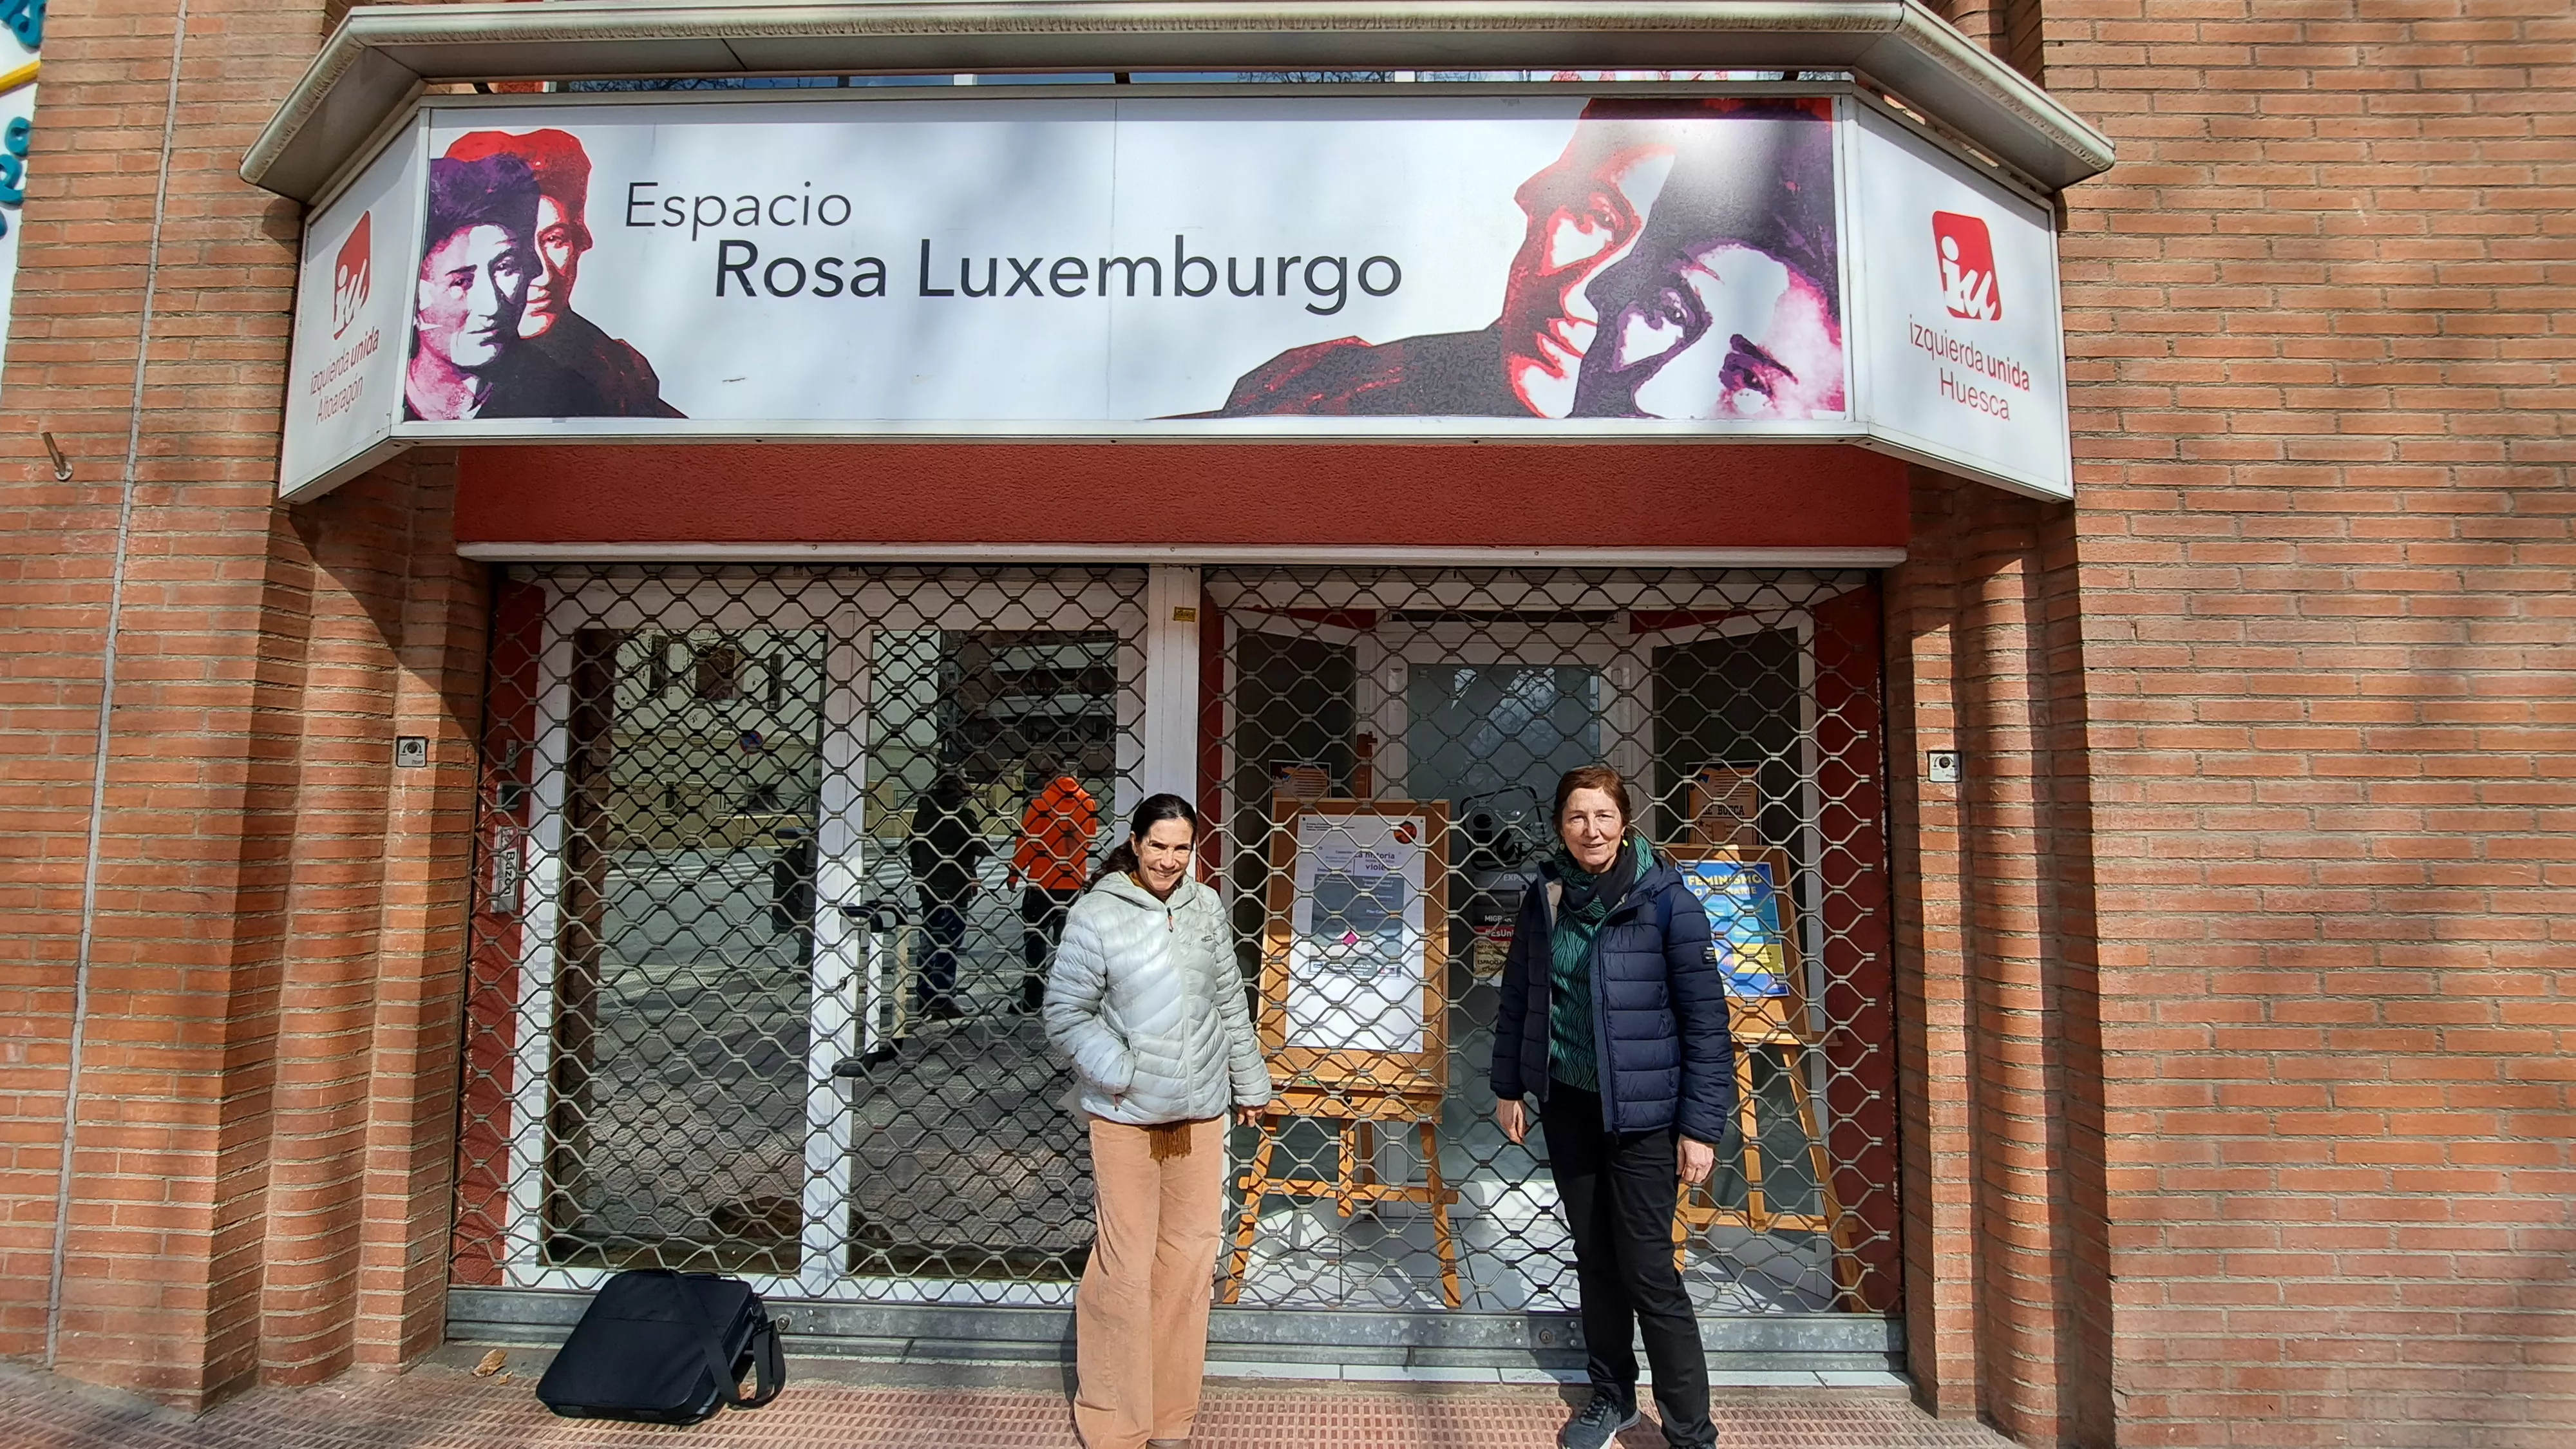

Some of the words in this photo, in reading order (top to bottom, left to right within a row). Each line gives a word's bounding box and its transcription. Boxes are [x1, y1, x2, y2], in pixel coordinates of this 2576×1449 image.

[625, 181, 853, 242] Espacio
[715, 239, 888, 298] Rosa
[919, 234, 1403, 316] Luxemburgo
[310, 347, 350, 397] izquierda
[350, 326, 380, 368] unida
[1908, 314, 1985, 374] izquierda
[1986, 353, 2030, 392] unida
[316, 372, 364, 426] Altoaragón
[1939, 367, 2010, 422] Huesca
[1365, 851, 1395, 859] hioria
